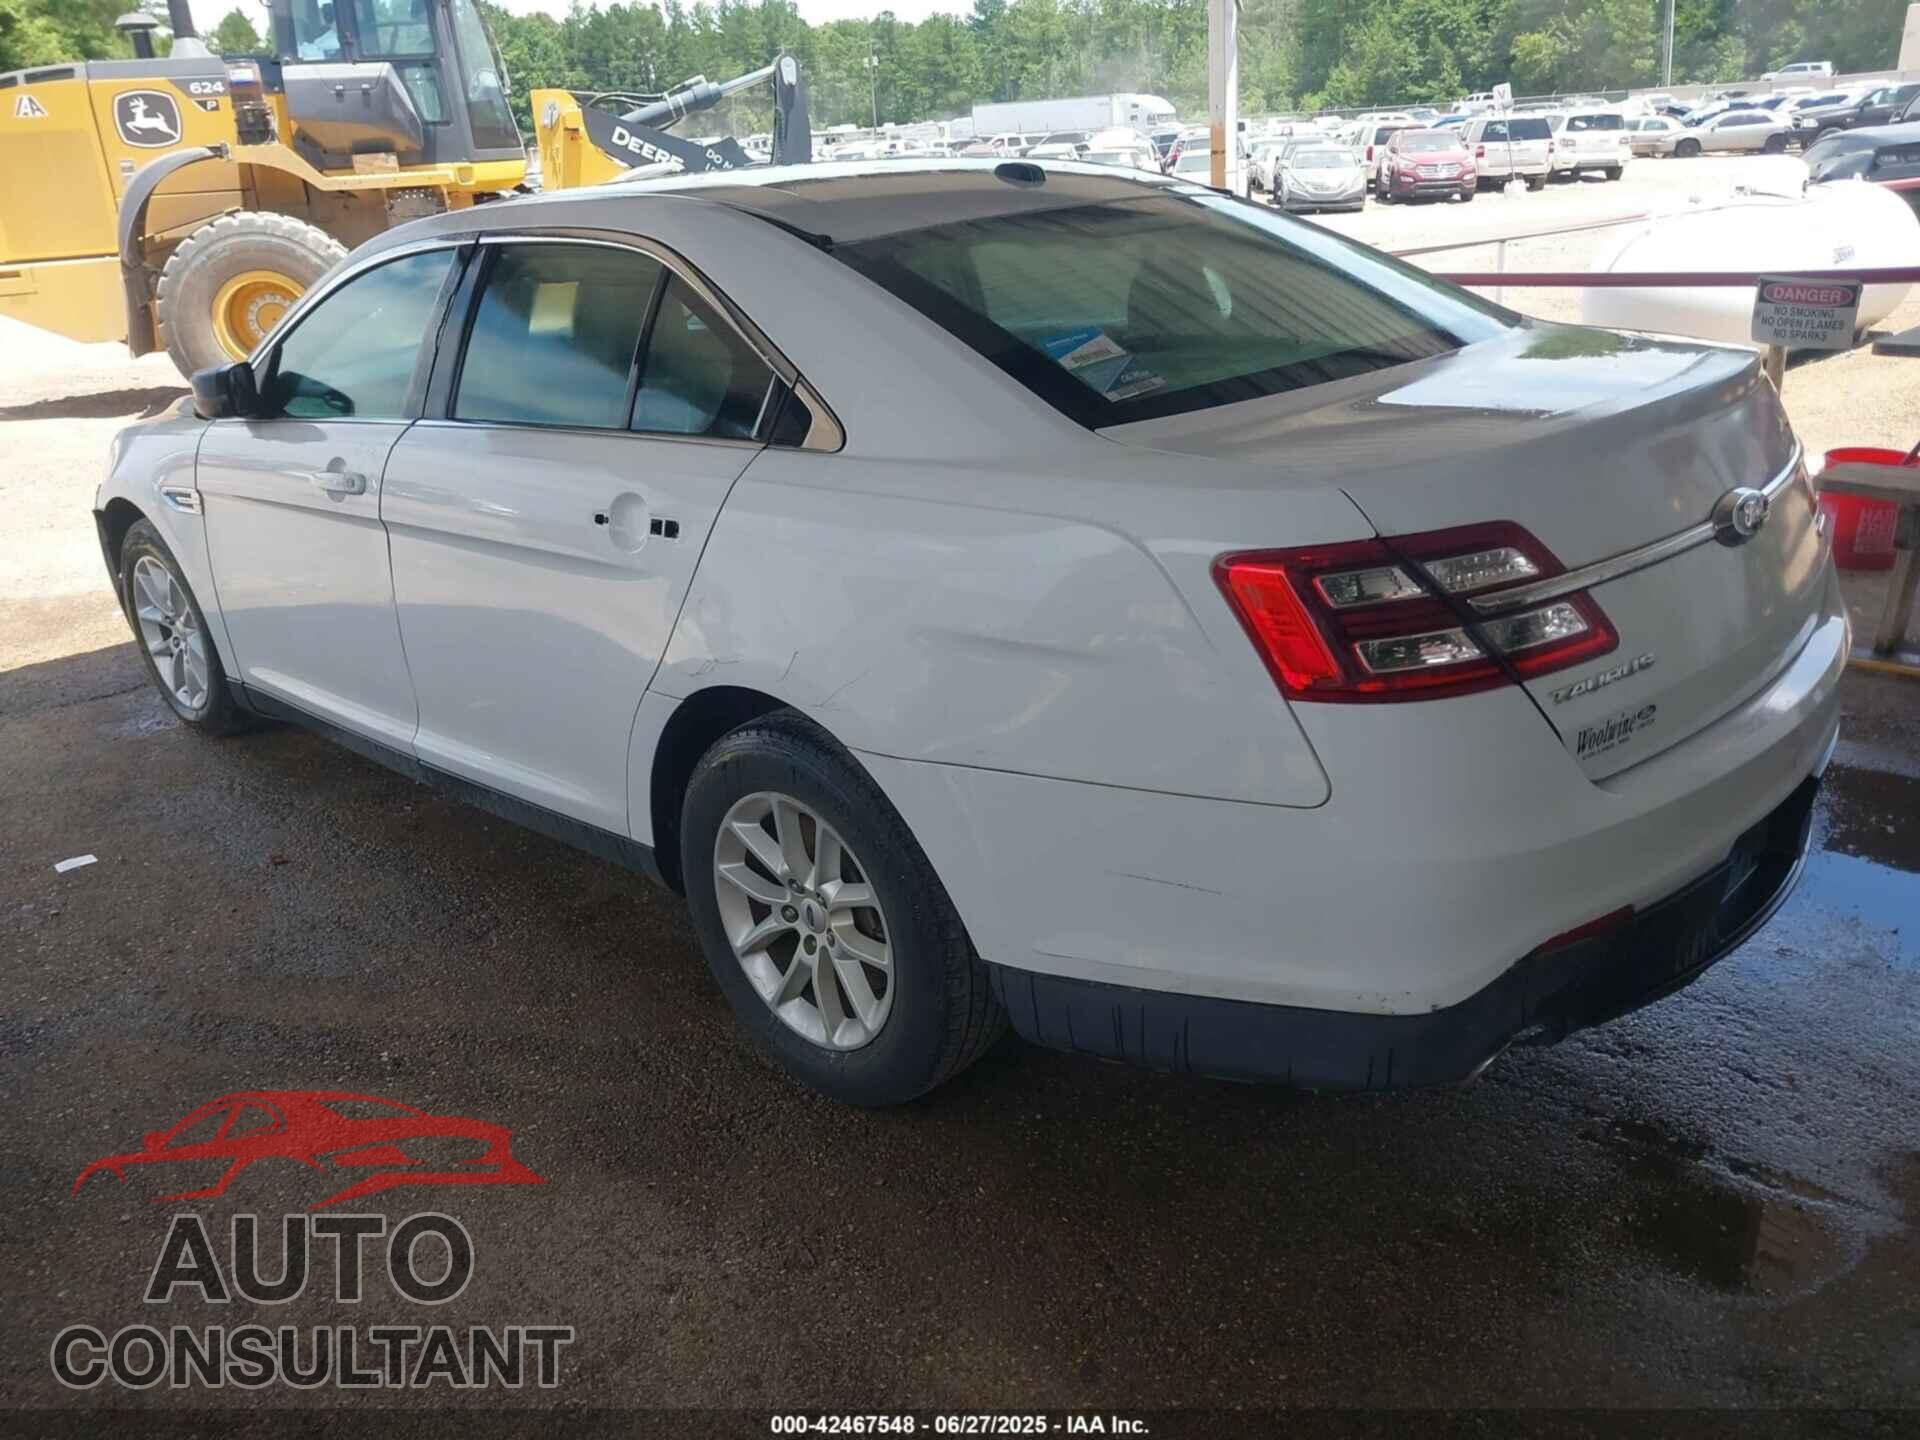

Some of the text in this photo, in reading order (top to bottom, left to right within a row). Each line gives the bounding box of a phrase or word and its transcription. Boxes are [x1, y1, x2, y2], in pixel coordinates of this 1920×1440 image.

[189, 81, 225, 94] 624
[206, 100, 217, 110] P
[611, 126, 686, 170] DEERE
[705, 148, 722, 164] DO
[1773, 287, 1841, 304] DANGER
[1774, 306, 1835, 318] NO SMOKING
[1761, 314, 1844, 330] NO OPEN FLAMES
[1773, 328, 1827, 341] NO SPARKS
[1549, 652, 1656, 704] TAURUS
